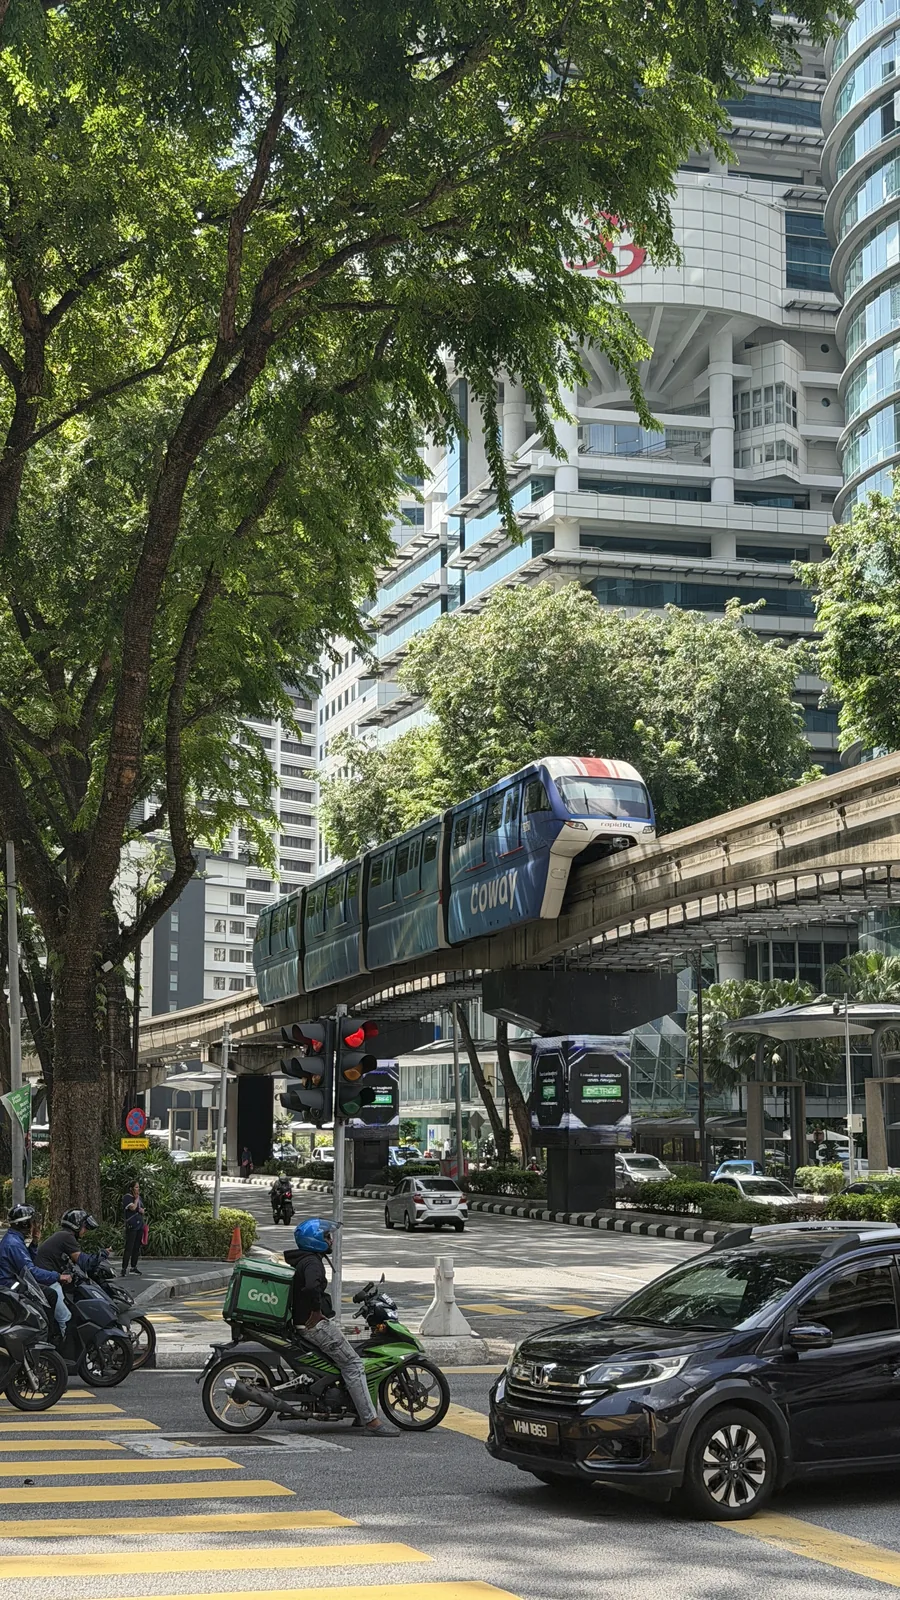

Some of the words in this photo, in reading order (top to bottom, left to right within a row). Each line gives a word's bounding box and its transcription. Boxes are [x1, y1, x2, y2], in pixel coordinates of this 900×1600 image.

[470, 871, 518, 915] coway
[247, 1288, 279, 1305] Grab
[513, 1419, 530, 1435] VHM
